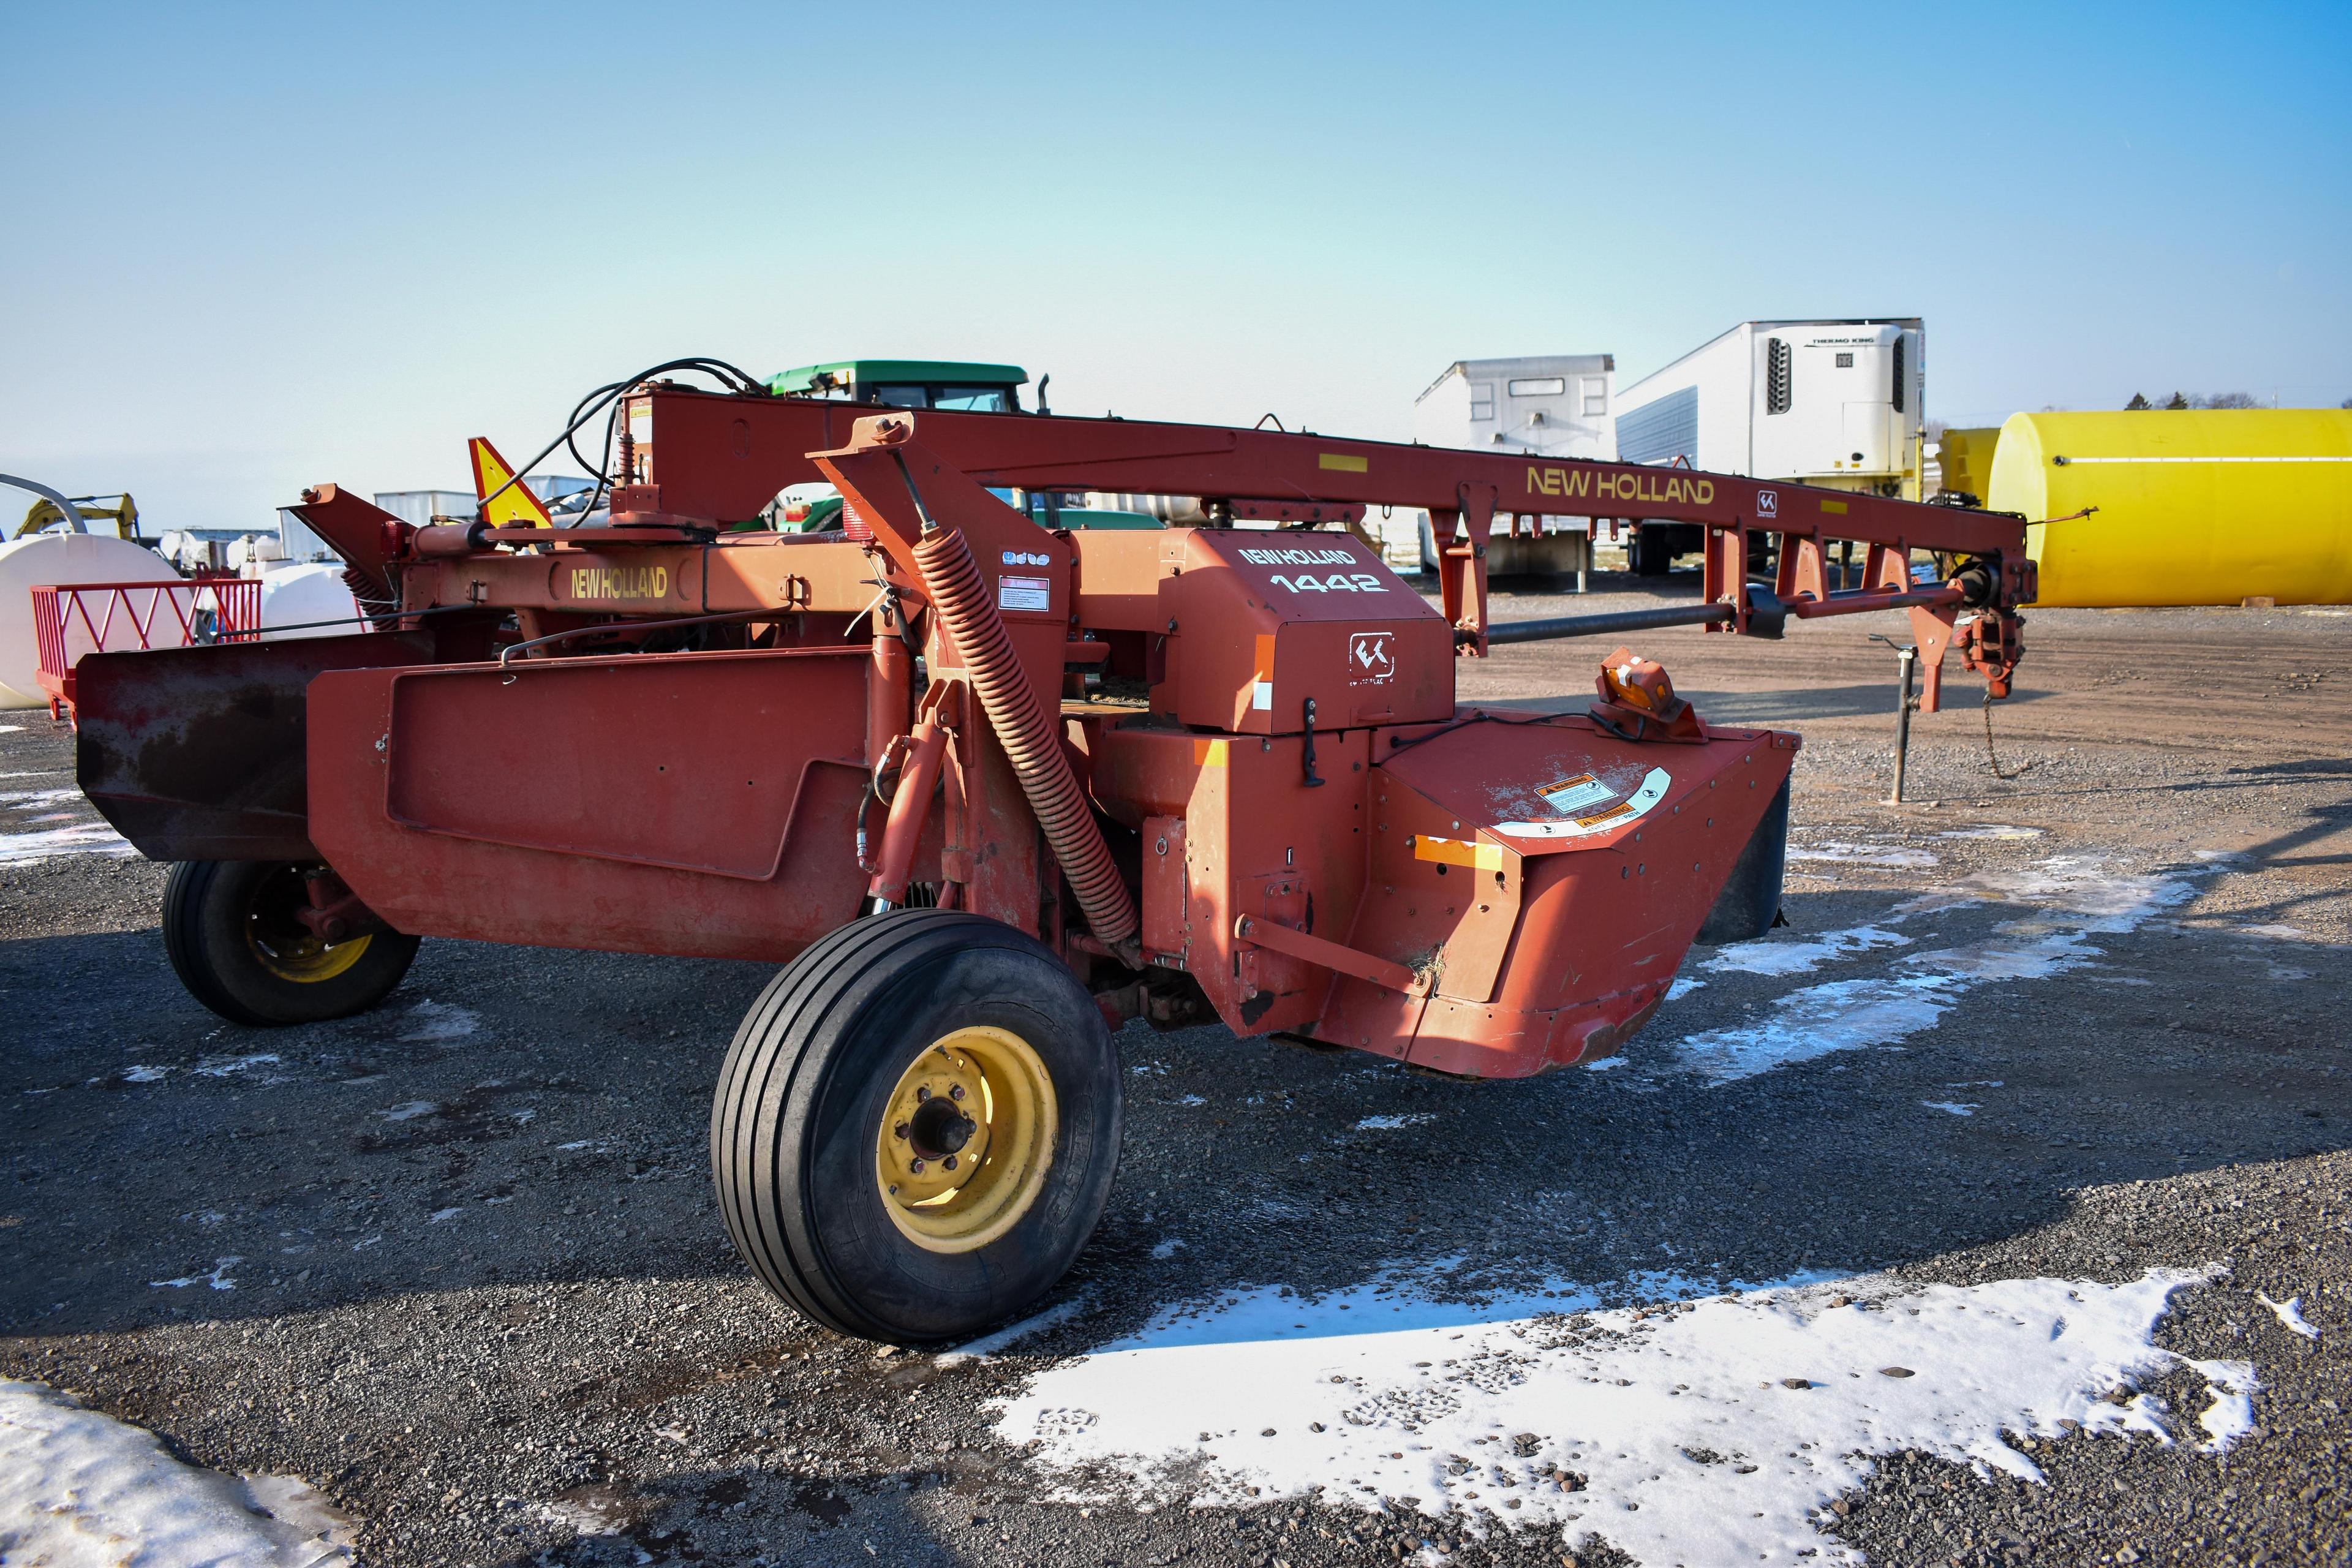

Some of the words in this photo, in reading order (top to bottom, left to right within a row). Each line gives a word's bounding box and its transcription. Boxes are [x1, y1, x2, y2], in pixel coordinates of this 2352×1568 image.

[1527, 467, 1591, 497] NEW
[1597, 472, 1714, 505] HOLLAND
[1238, 549, 1284, 564] NEW
[1278, 549, 1357, 565] HOLLAND
[571, 568, 600, 598] NEW
[601, 567, 668, 599] HOLLAND
[1270, 574, 1390, 593] 1442
[1553, 777, 1588, 790] WARNING
[1590, 806, 1630, 822] WARNING
